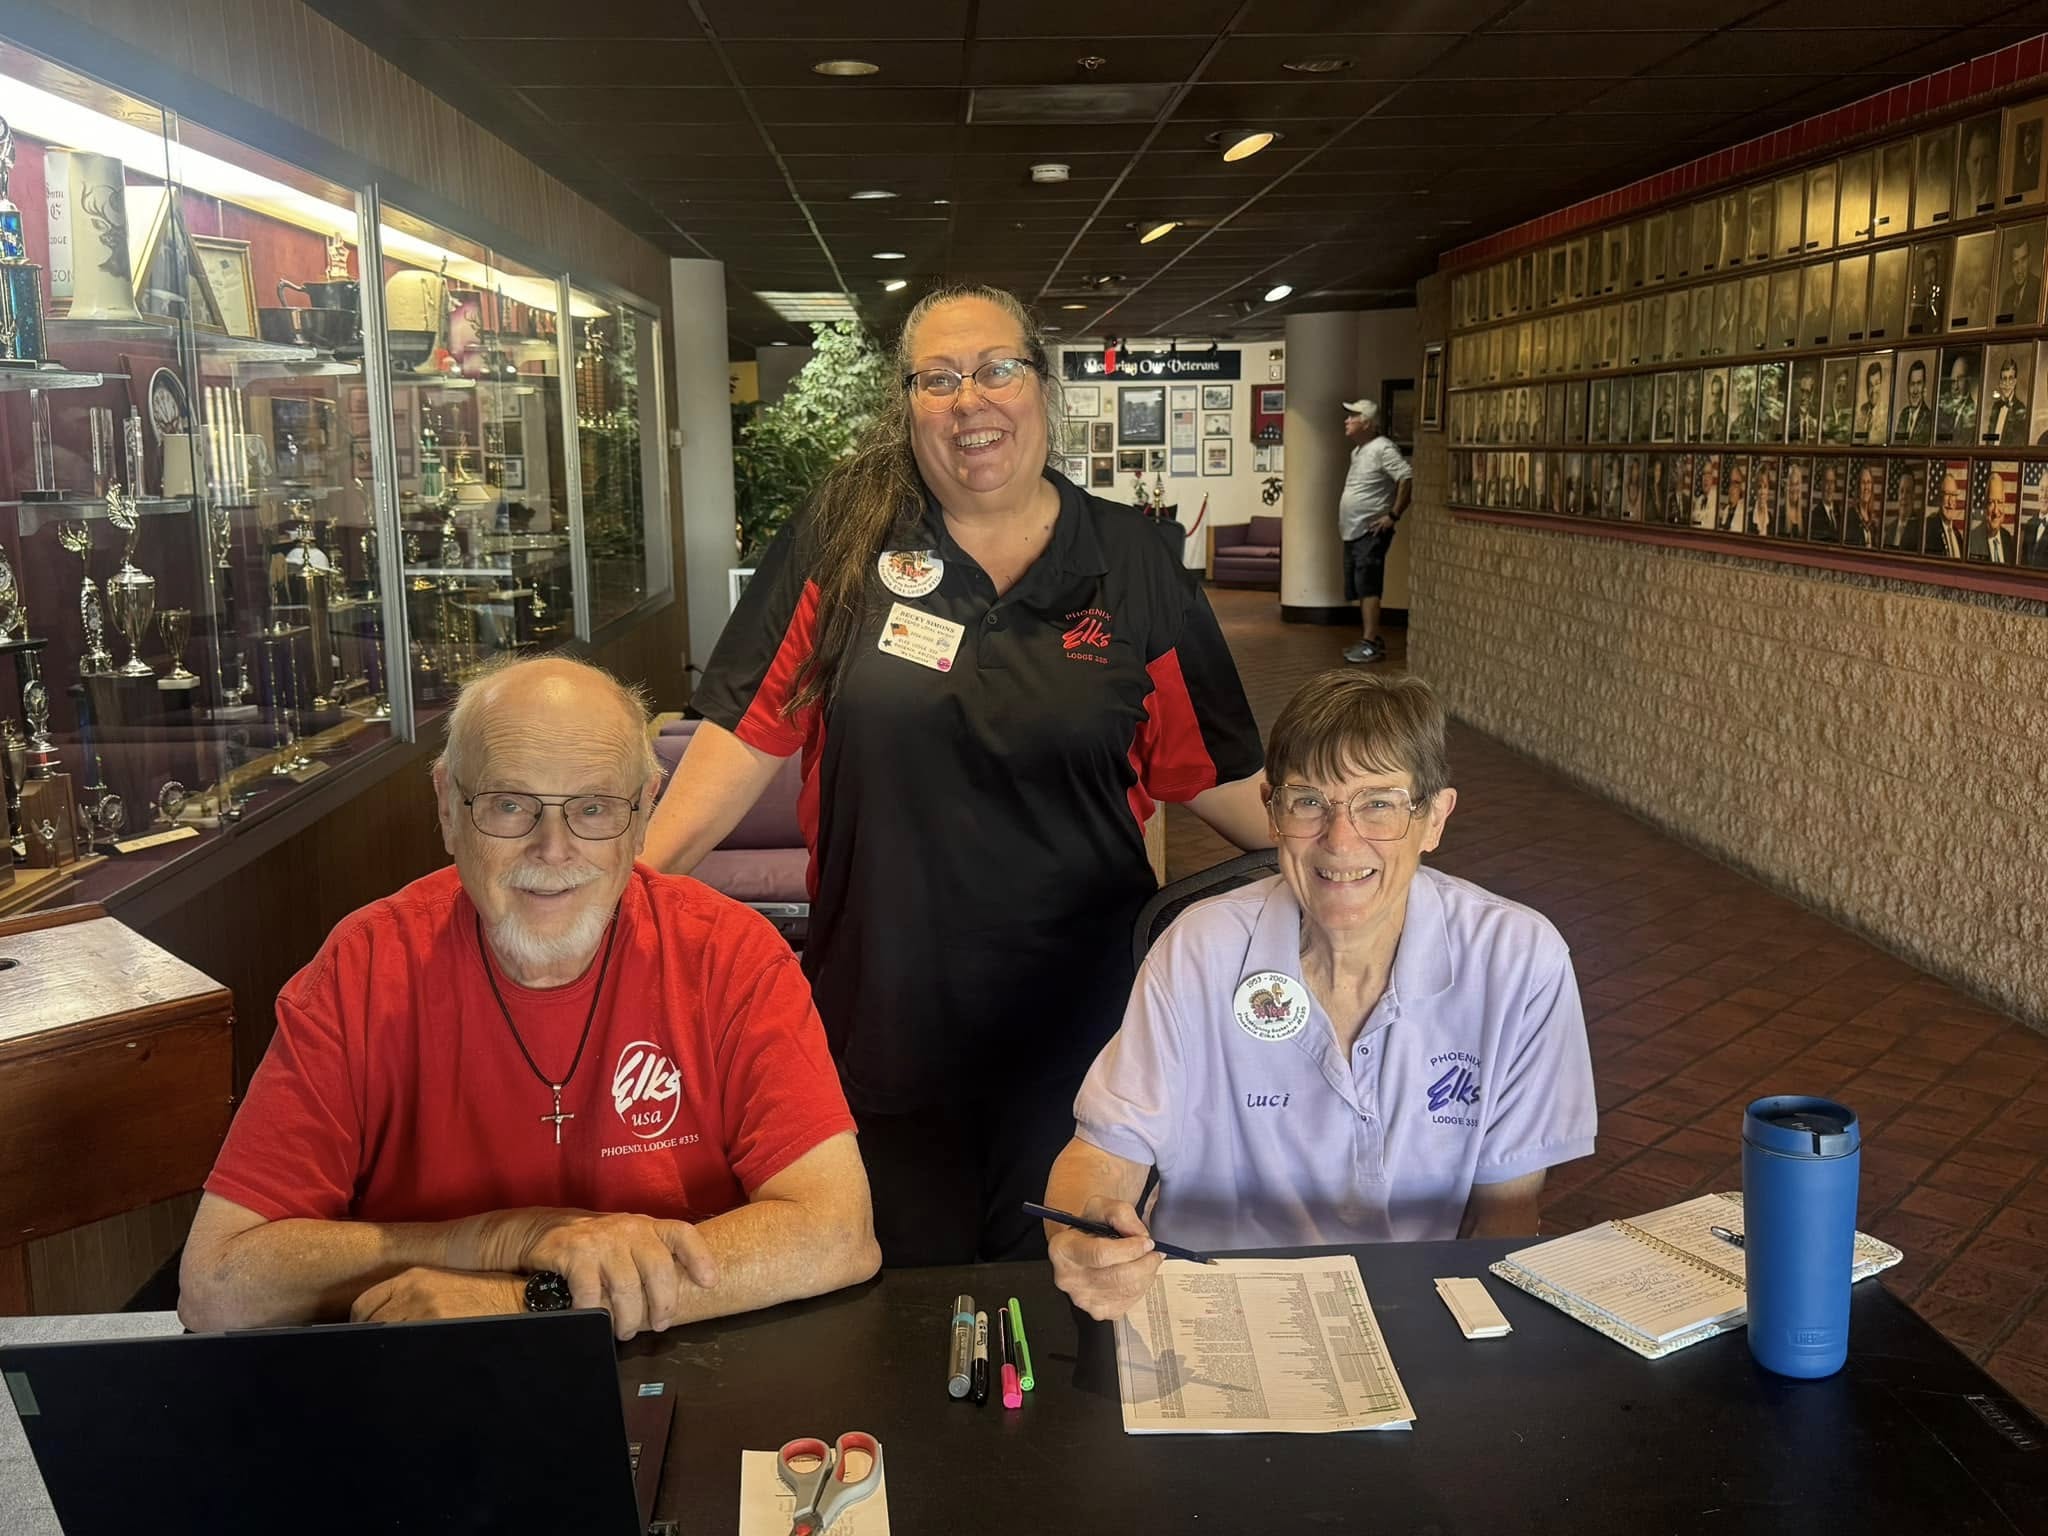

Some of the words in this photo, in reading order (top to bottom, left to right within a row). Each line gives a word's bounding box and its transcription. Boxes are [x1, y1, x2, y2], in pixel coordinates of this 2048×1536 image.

[1084, 358, 1138, 376] Horing
[1140, 359, 1165, 374] Our
[1167, 359, 1219, 373] Veterans
[1065, 608, 1111, 621] PHOENIX
[1062, 617, 1111, 649] Elks
[1066, 652, 1093, 661] LODGE
[1430, 1051, 1480, 1068] PHOENIX
[612, 1050, 682, 1114] Elks
[1427, 1065, 1480, 1112] Elks
[1247, 1093, 1290, 1107] Luci
[631, 1110, 662, 1126] usa
[1432, 1114, 1464, 1125] LODGE
[601, 1144, 643, 1158] PHOENIX
[643, 1138, 677, 1153] LODGE
[678, 1133, 699, 1145] #335
